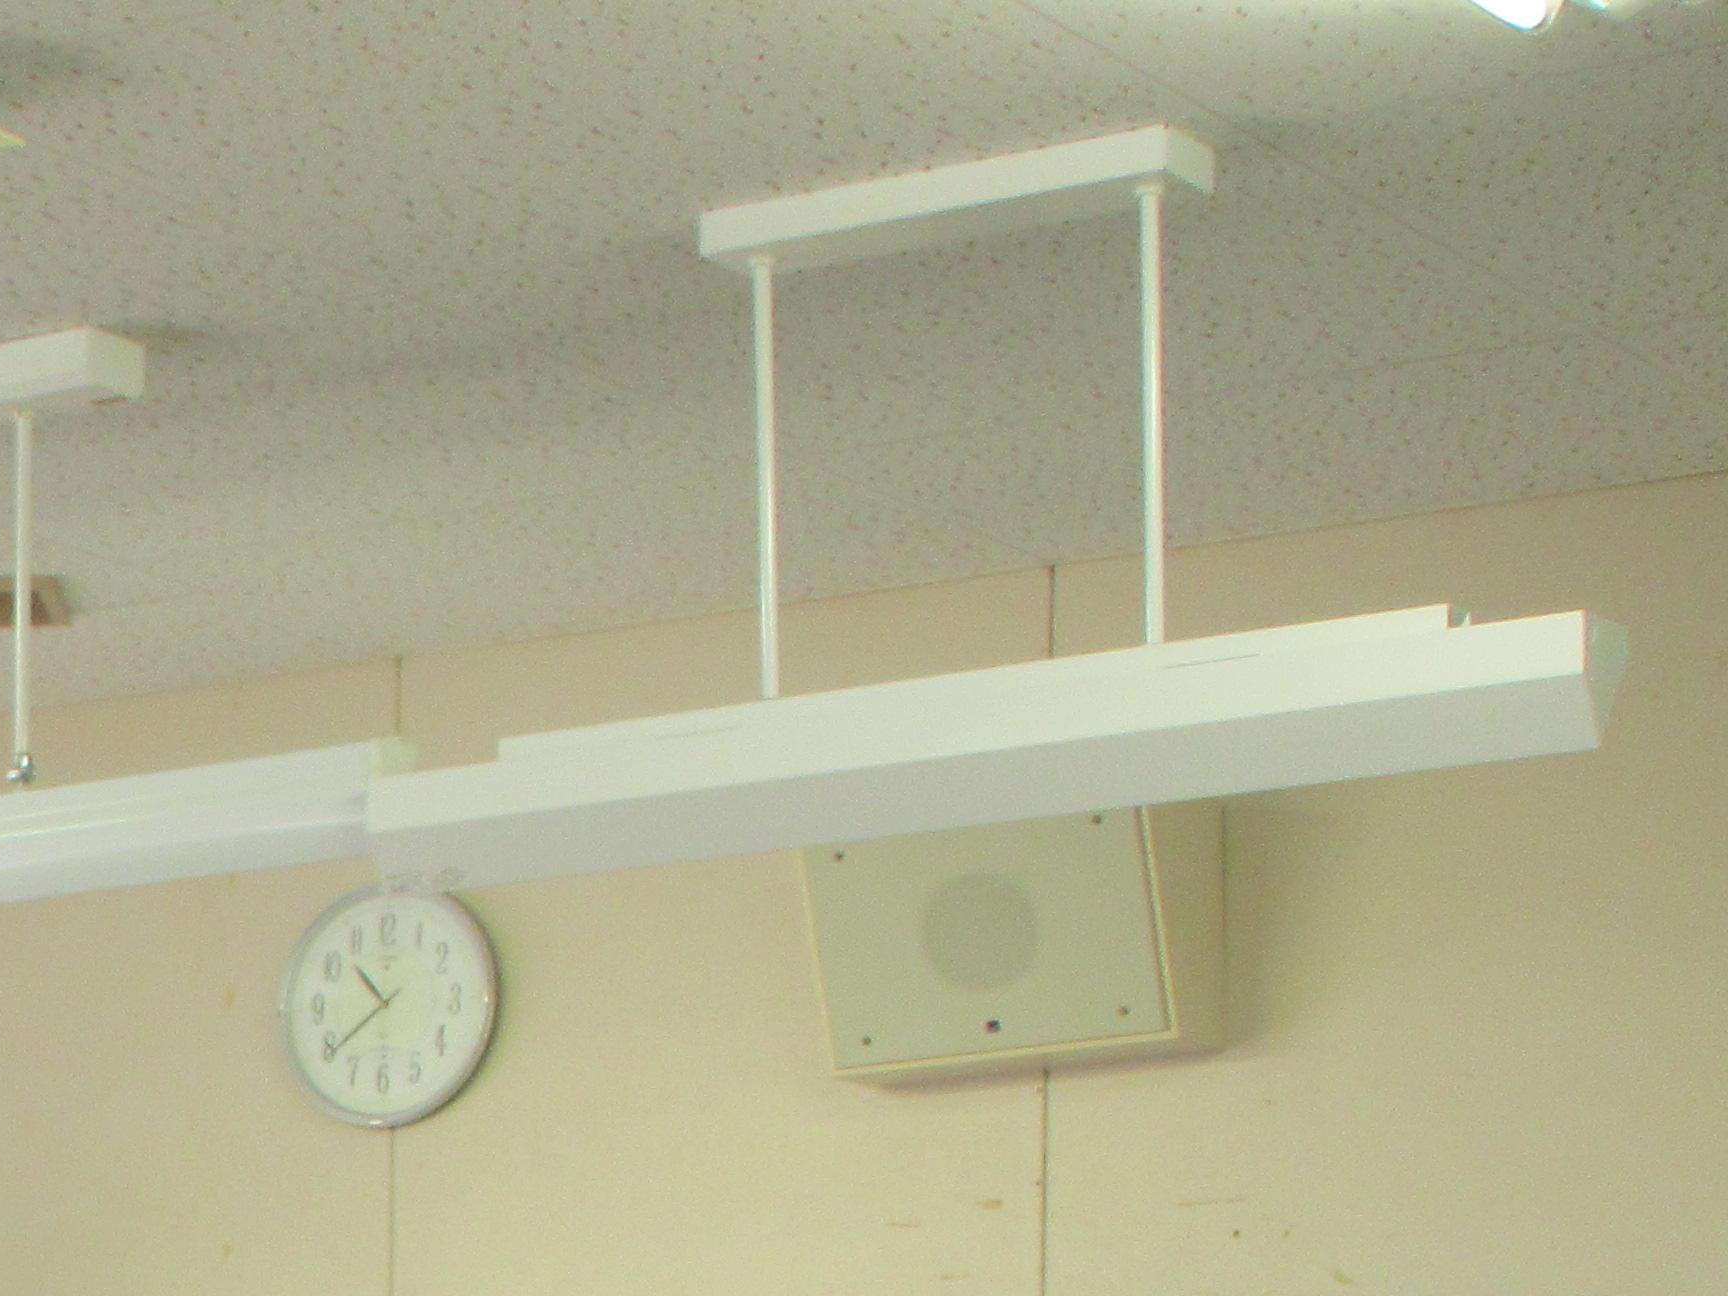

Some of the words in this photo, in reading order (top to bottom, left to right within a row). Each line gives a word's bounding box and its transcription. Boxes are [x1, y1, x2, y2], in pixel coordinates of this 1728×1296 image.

[415, 920, 424, 948] 1
[436, 941, 449, 975] 2
[311, 993, 326, 1027] 9
[448, 982, 462, 1016] 3
[347, 1055, 361, 1089] 7
[377, 1062, 390, 1095] 6
